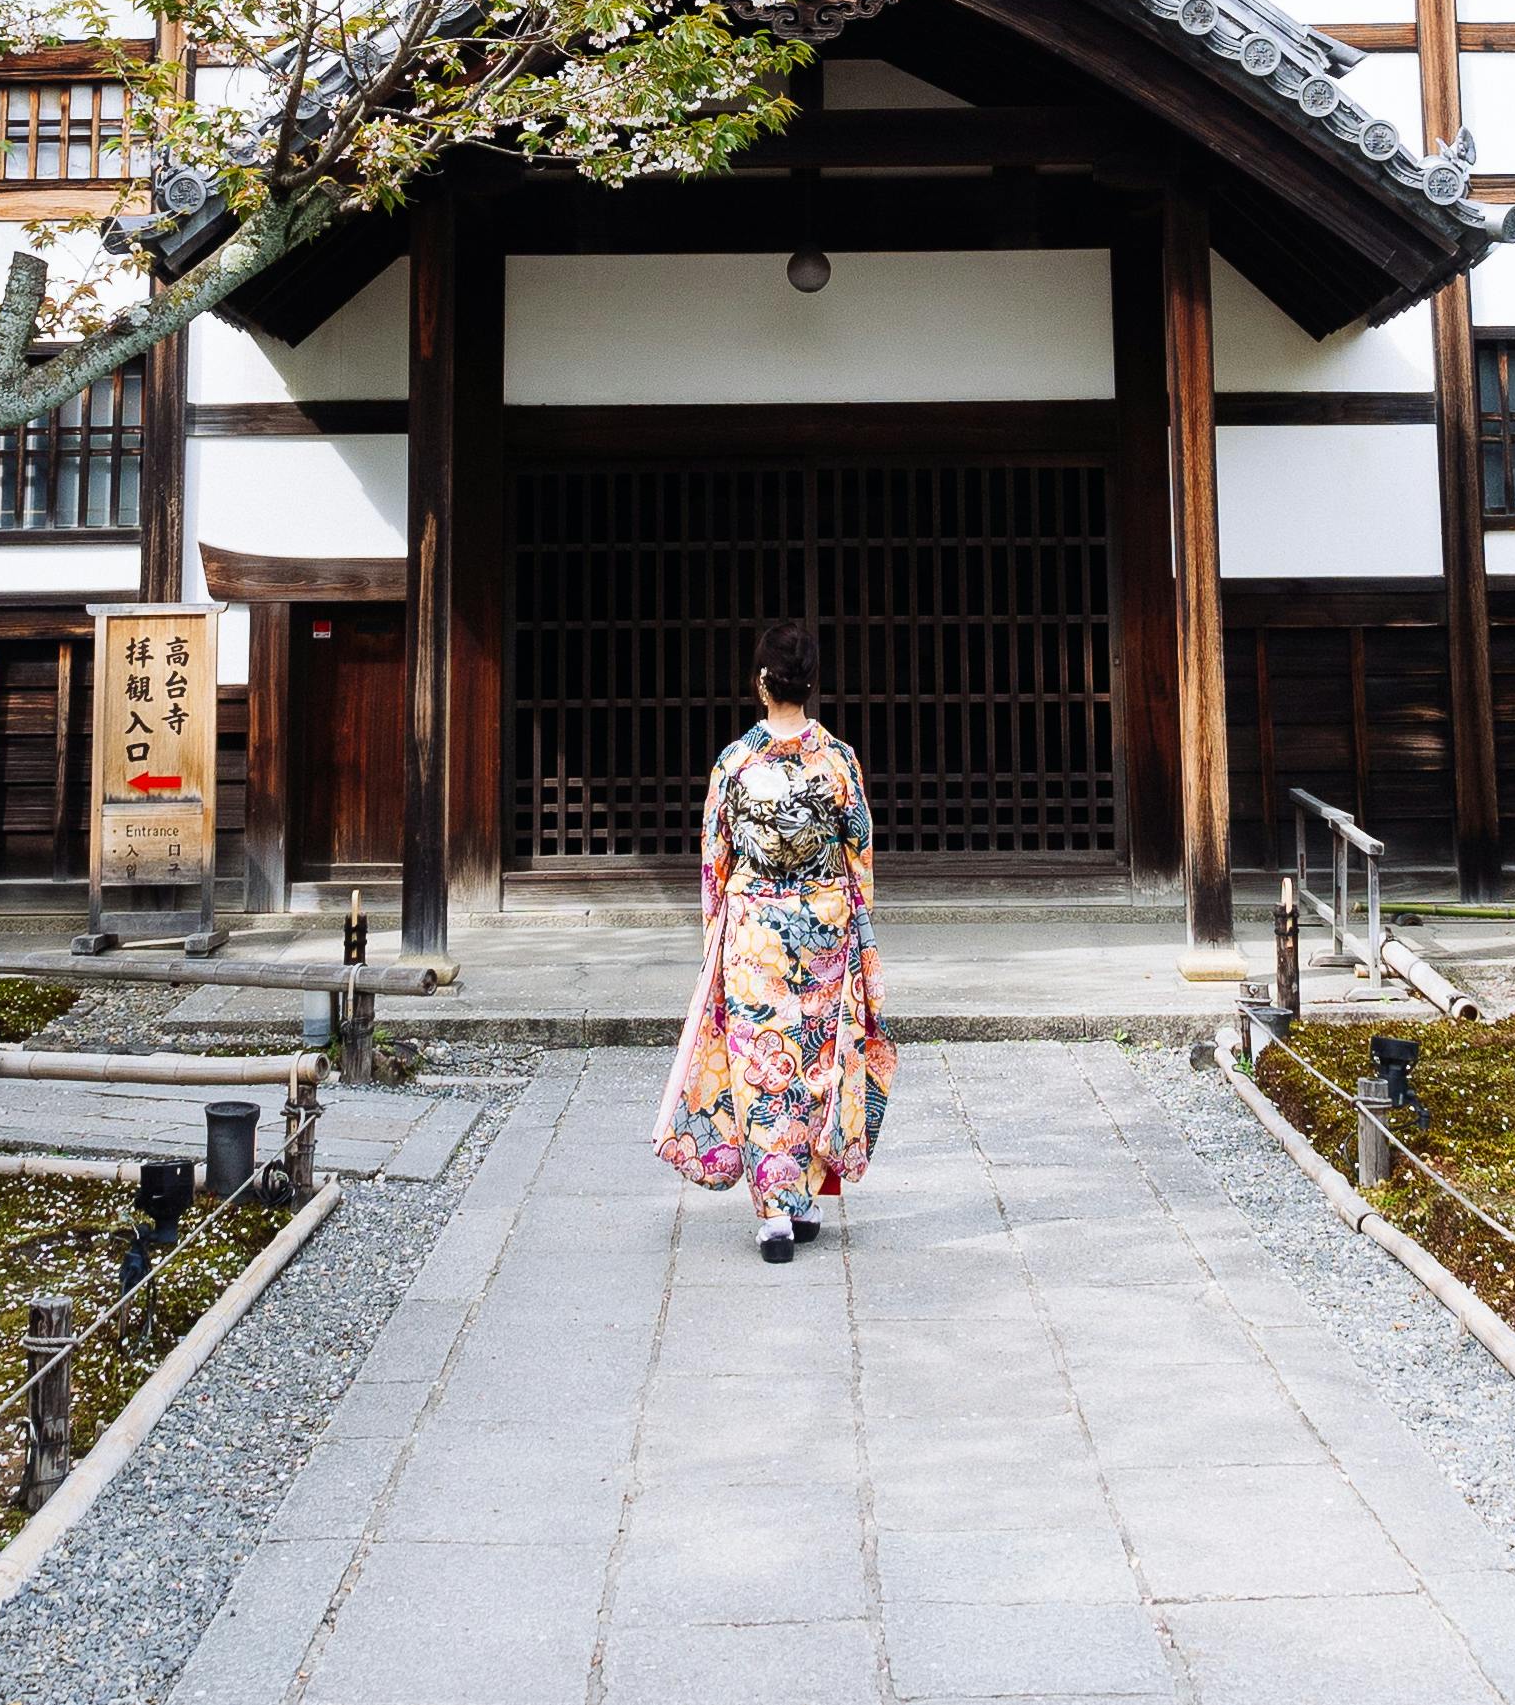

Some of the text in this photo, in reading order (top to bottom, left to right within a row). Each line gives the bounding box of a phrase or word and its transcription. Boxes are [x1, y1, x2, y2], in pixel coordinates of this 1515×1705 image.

[125, 636, 155, 763] 拝観入口
[162, 636, 190, 736] 高台寺
[126, 824, 179, 837] Entrance
